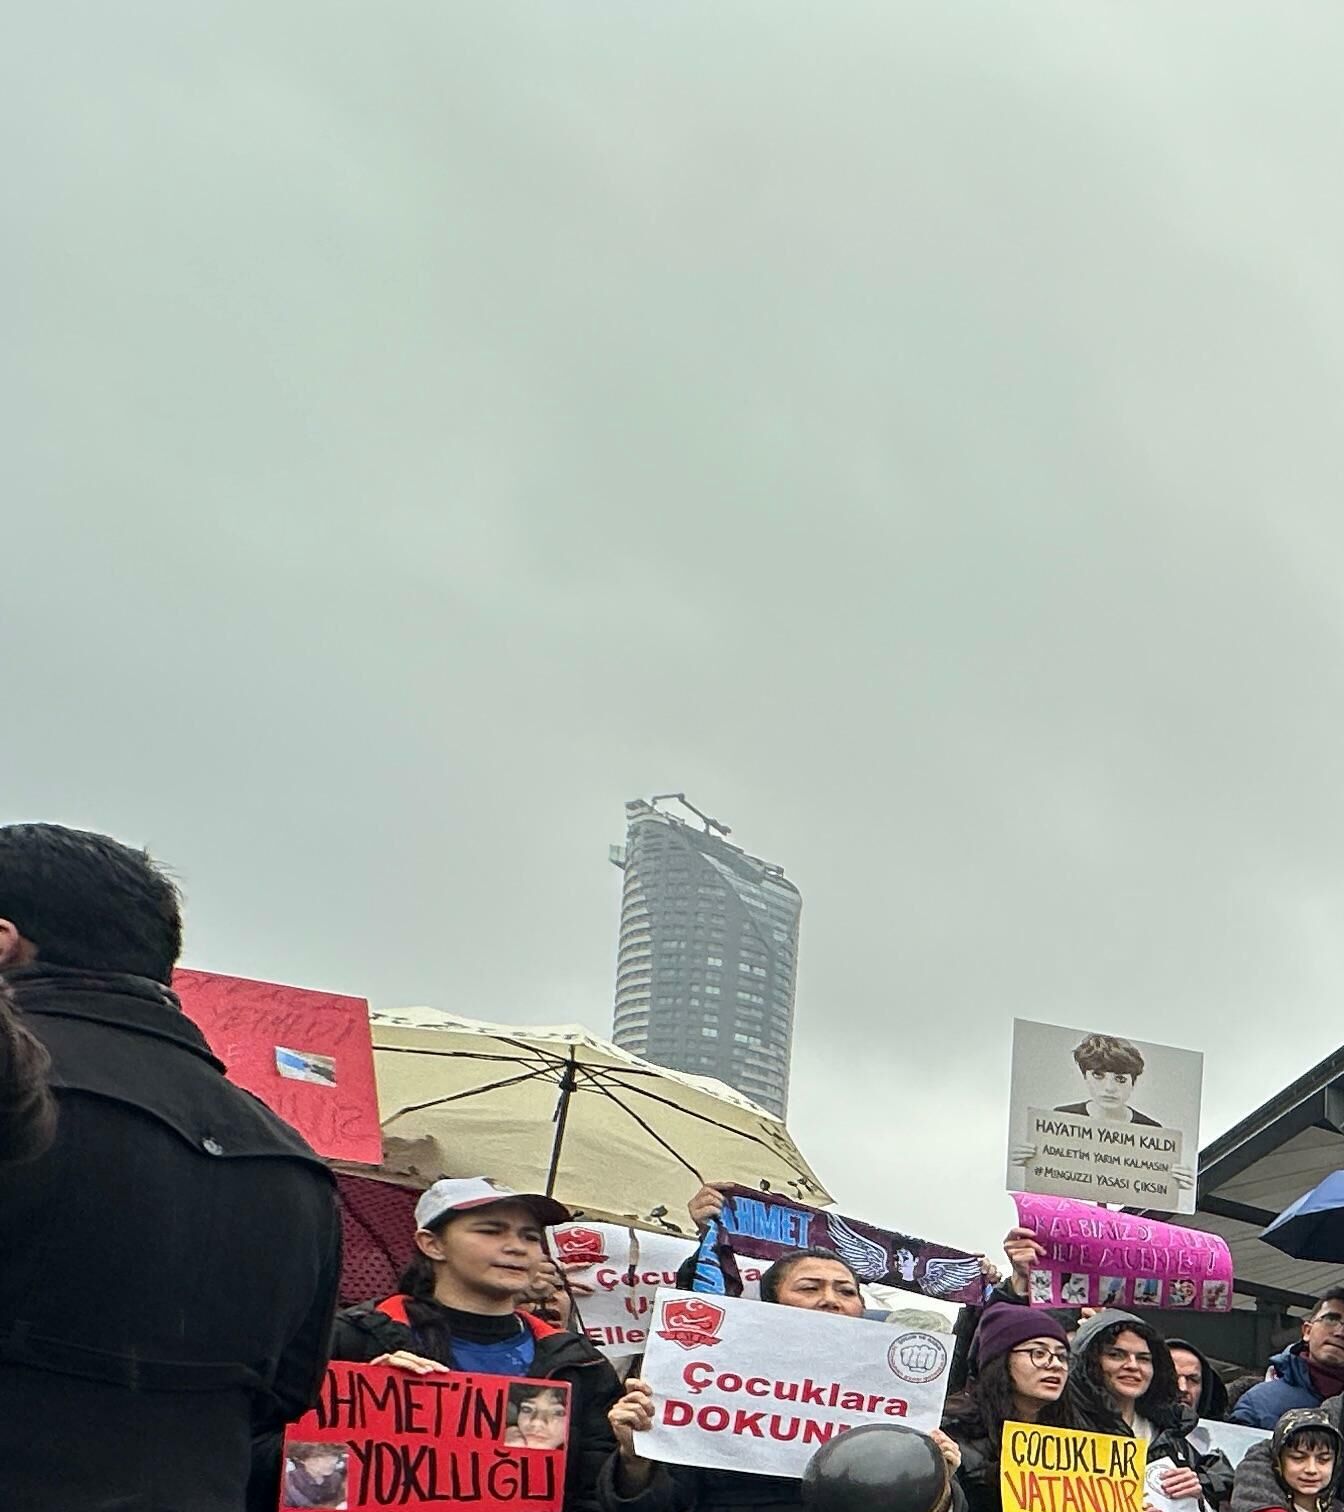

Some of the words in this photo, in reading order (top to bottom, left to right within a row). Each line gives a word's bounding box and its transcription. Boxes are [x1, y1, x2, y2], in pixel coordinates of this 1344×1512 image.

[1036, 1119, 1093, 1140] HAYATIM
[1097, 1128, 1135, 1147] YARIM
[1139, 1136, 1176, 1153] KALDI
[1094, 1152, 1121, 1166] YARIM
[1124, 1157, 1169, 1173] KALMASIN
[1096, 1174, 1130, 1190] YASASI
[1133, 1179, 1168, 1195] ÇIKSIN
[585, 1326, 649, 1347] Elle
[316, 1369, 504, 1441] HMET'İN
[682, 1361, 909, 1418] Çocuklara
[662, 1399, 852, 1446] DOKUN
[346, 1439, 556, 1506] YOKLUĞU
[1011, 1430, 1140, 1480] ÇOCUKLAR
